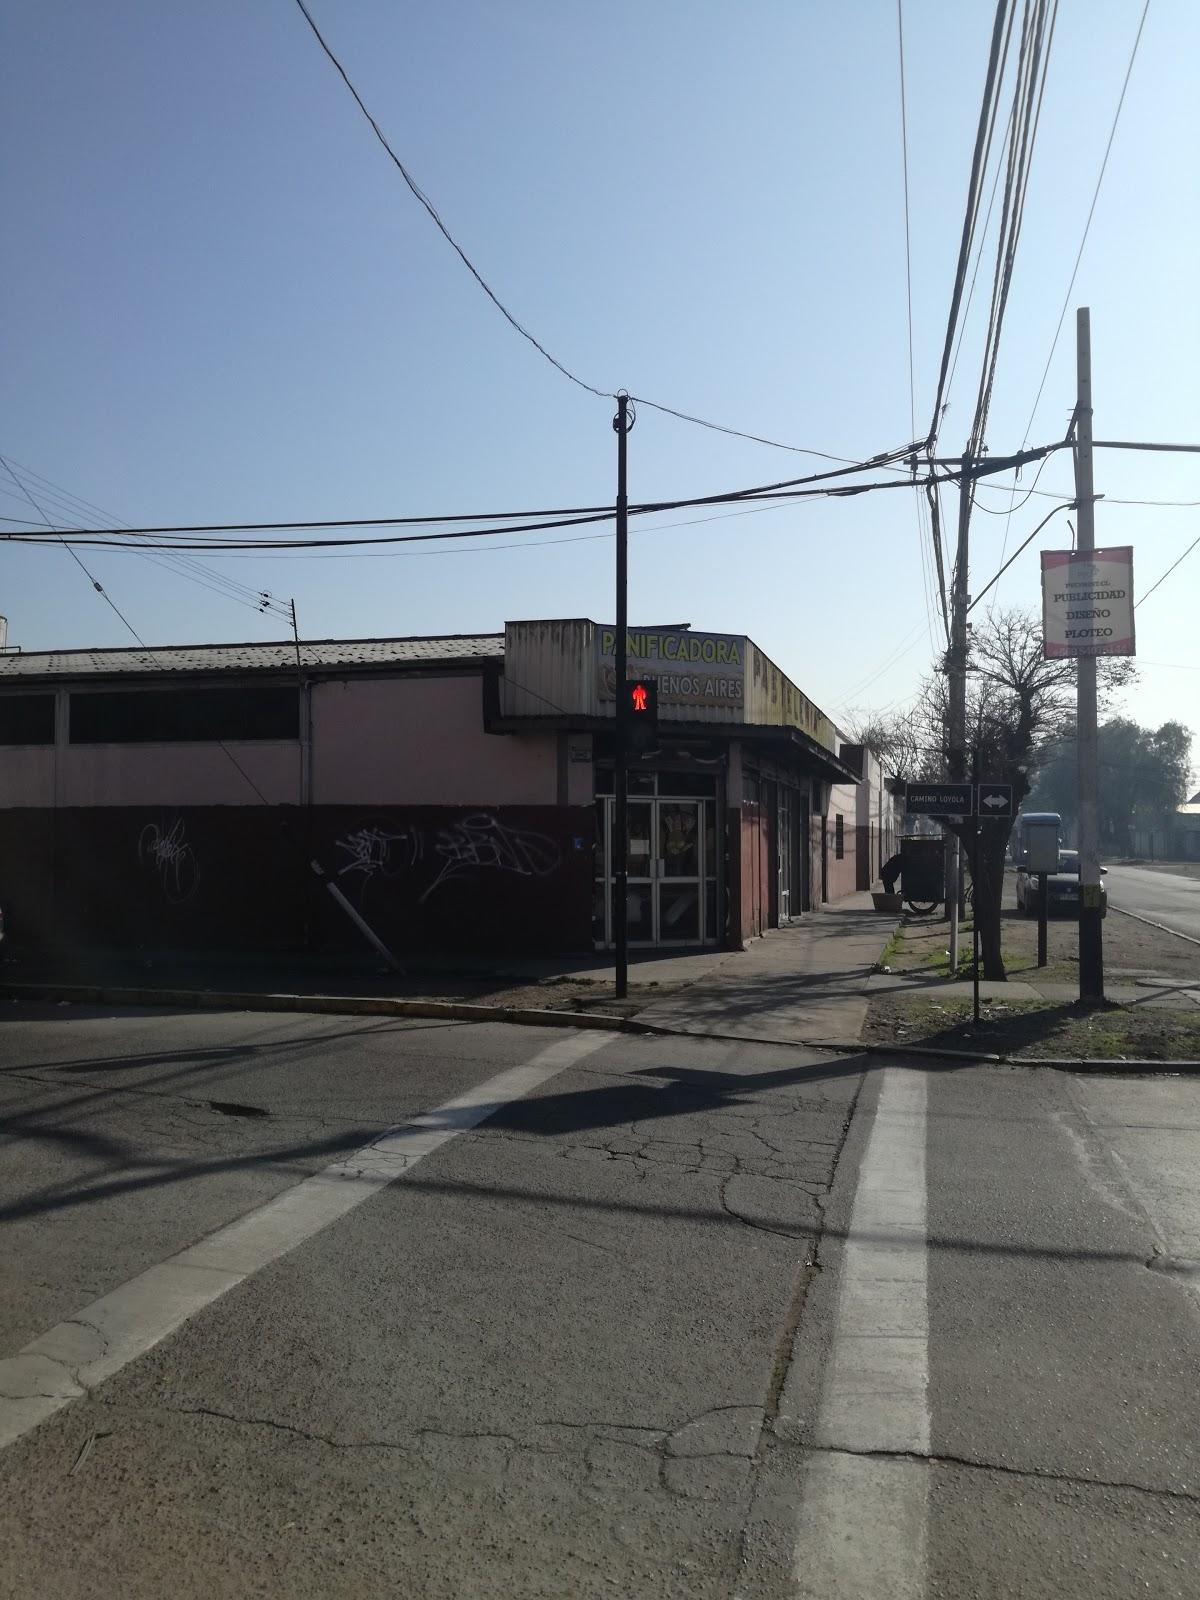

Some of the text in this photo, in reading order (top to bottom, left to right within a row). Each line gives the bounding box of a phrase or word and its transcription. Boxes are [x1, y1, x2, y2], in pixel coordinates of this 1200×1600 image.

[1053, 589, 1126, 603] PUBLICIDAD
[1066, 607, 1111, 620] DISEÑO
[1065, 627, 1113, 639] PLOTEO
[642, 674, 742, 698] UENOS AIRES
[910, 795, 965, 804] CAMINO LOYOLA
